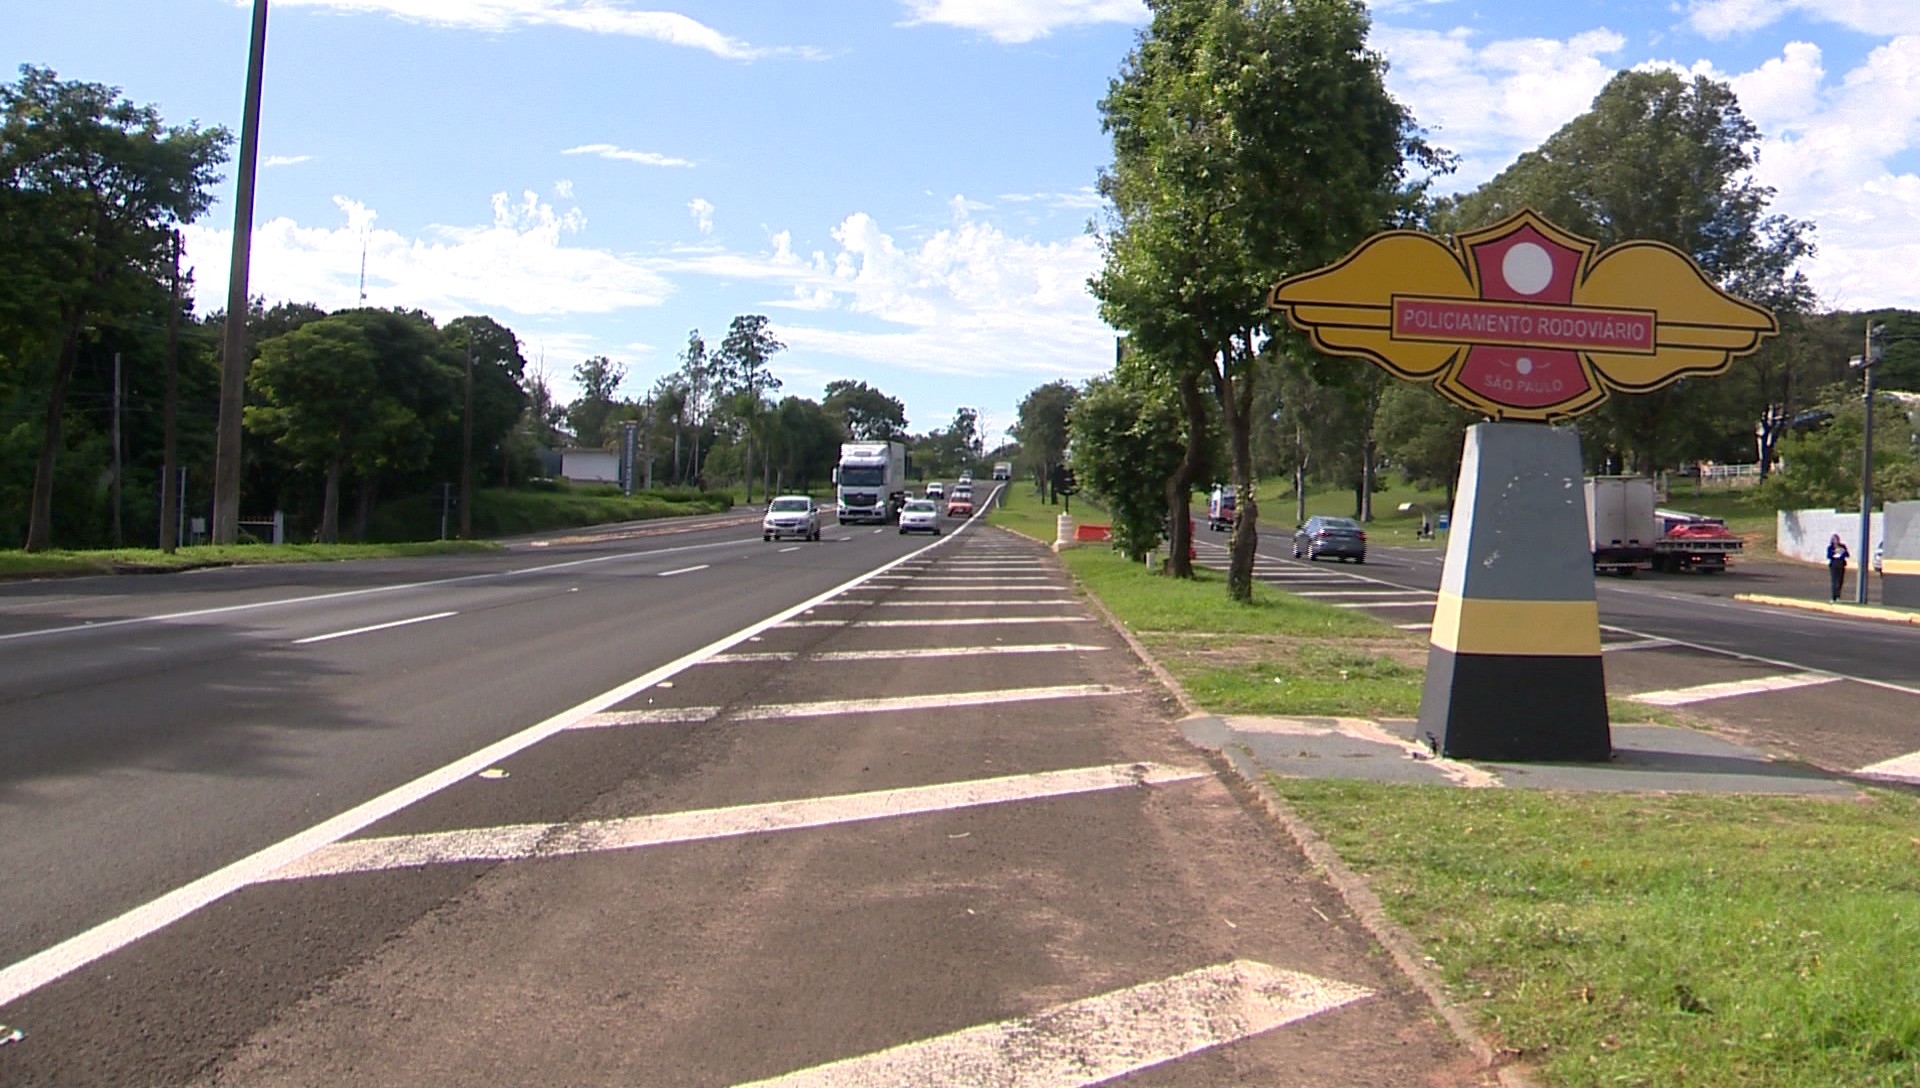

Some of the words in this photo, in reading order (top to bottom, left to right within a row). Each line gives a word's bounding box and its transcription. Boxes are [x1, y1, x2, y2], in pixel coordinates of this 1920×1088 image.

[1403, 309, 1532, 334] POLICIAMENTO
[1537, 317, 1644, 341] RODOVIÁRIO
[1517, 379, 1563, 393] PAULO
